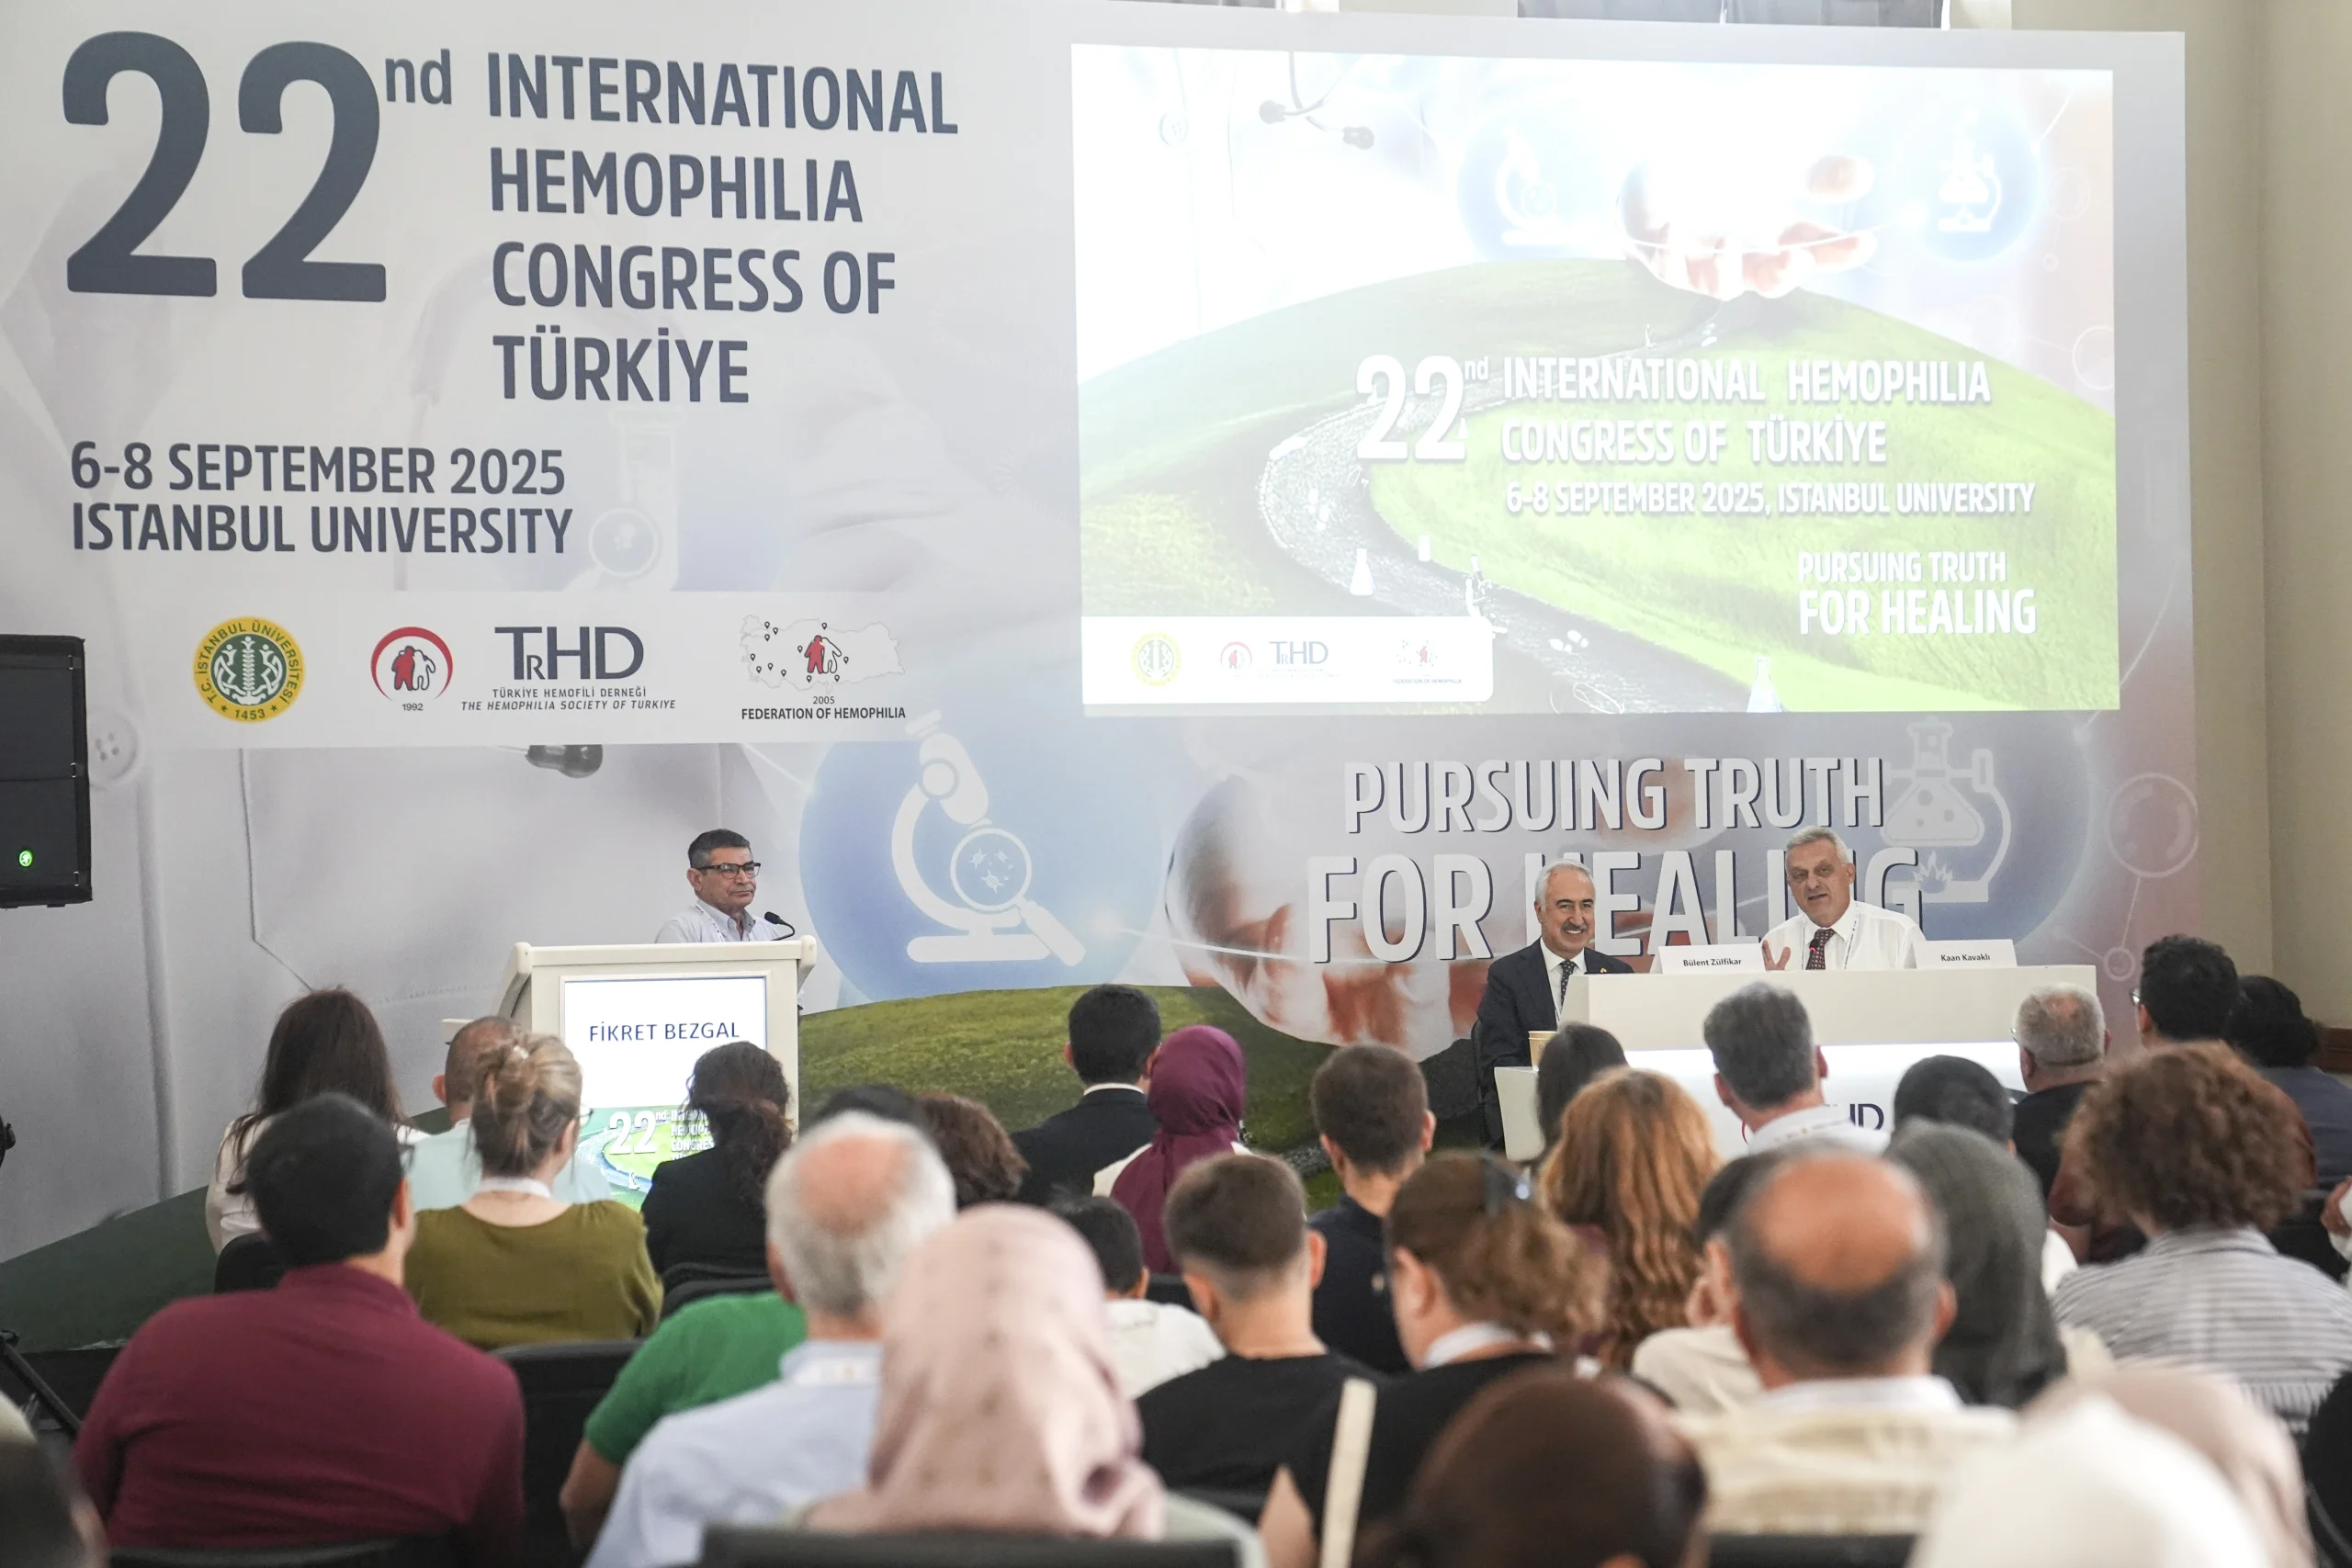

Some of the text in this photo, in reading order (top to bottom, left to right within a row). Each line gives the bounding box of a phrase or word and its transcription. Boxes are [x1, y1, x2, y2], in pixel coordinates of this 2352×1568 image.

[488, 52, 958, 134] INTERNATIONAL
[491, 147, 863, 222] HEMOPHILIA
[492, 241, 895, 314] CONGRESS OF
[492, 324, 749, 402] TÜRKİYE
[1503, 356, 1766, 401] INTERNATIONAL
[1791, 359, 1993, 402] HEMOPHILIA
[1501, 413, 1887, 462] CONGRESS OF TÜRKİYE
[72, 441, 565, 494] 6-8 SEPTEMBER 2025
[1507, 481, 2036, 515] 6-8 SEPTEMBER 2025, ISTANBUL UNIVERSITY
[74, 502, 573, 553] ISTANBUL UNIVERSITY
[1798, 551, 2007, 582] PURSUING TRUTH
[1799, 589, 2038, 636] FOR HEALING
[195, 622, 247, 674] İSTANBUL
[252, 619, 302, 705] ÜNİVERSİTESİ
[235, 708, 266, 720] 1453
[401, 702, 424, 712] 1992
[461, 701, 482, 711] THE
[487, 701, 555, 710] HEMOPHILIA
[560, 700, 607, 710] SOCIETY
[613, 700, 627, 709] OF
[492, 685, 646, 698] TÜRKİYE HEMOFİLİ DERNEĞİ
[741, 707, 906, 719] FEDERATION OF HEMOPHILIA
[812, 695, 835, 705] 2005
[1344, 757, 1885, 834] PURSUING TRUTH
[1307, 852, 1494, 964] FOR
[1524, 847, 1924, 958] EALIG
[1682, 957, 1742, 967] Bülent Zülfikar
[1962, 953, 1990, 962] Kavaklı
[589, 1021, 740, 1042] FİKRET BEZGAL
